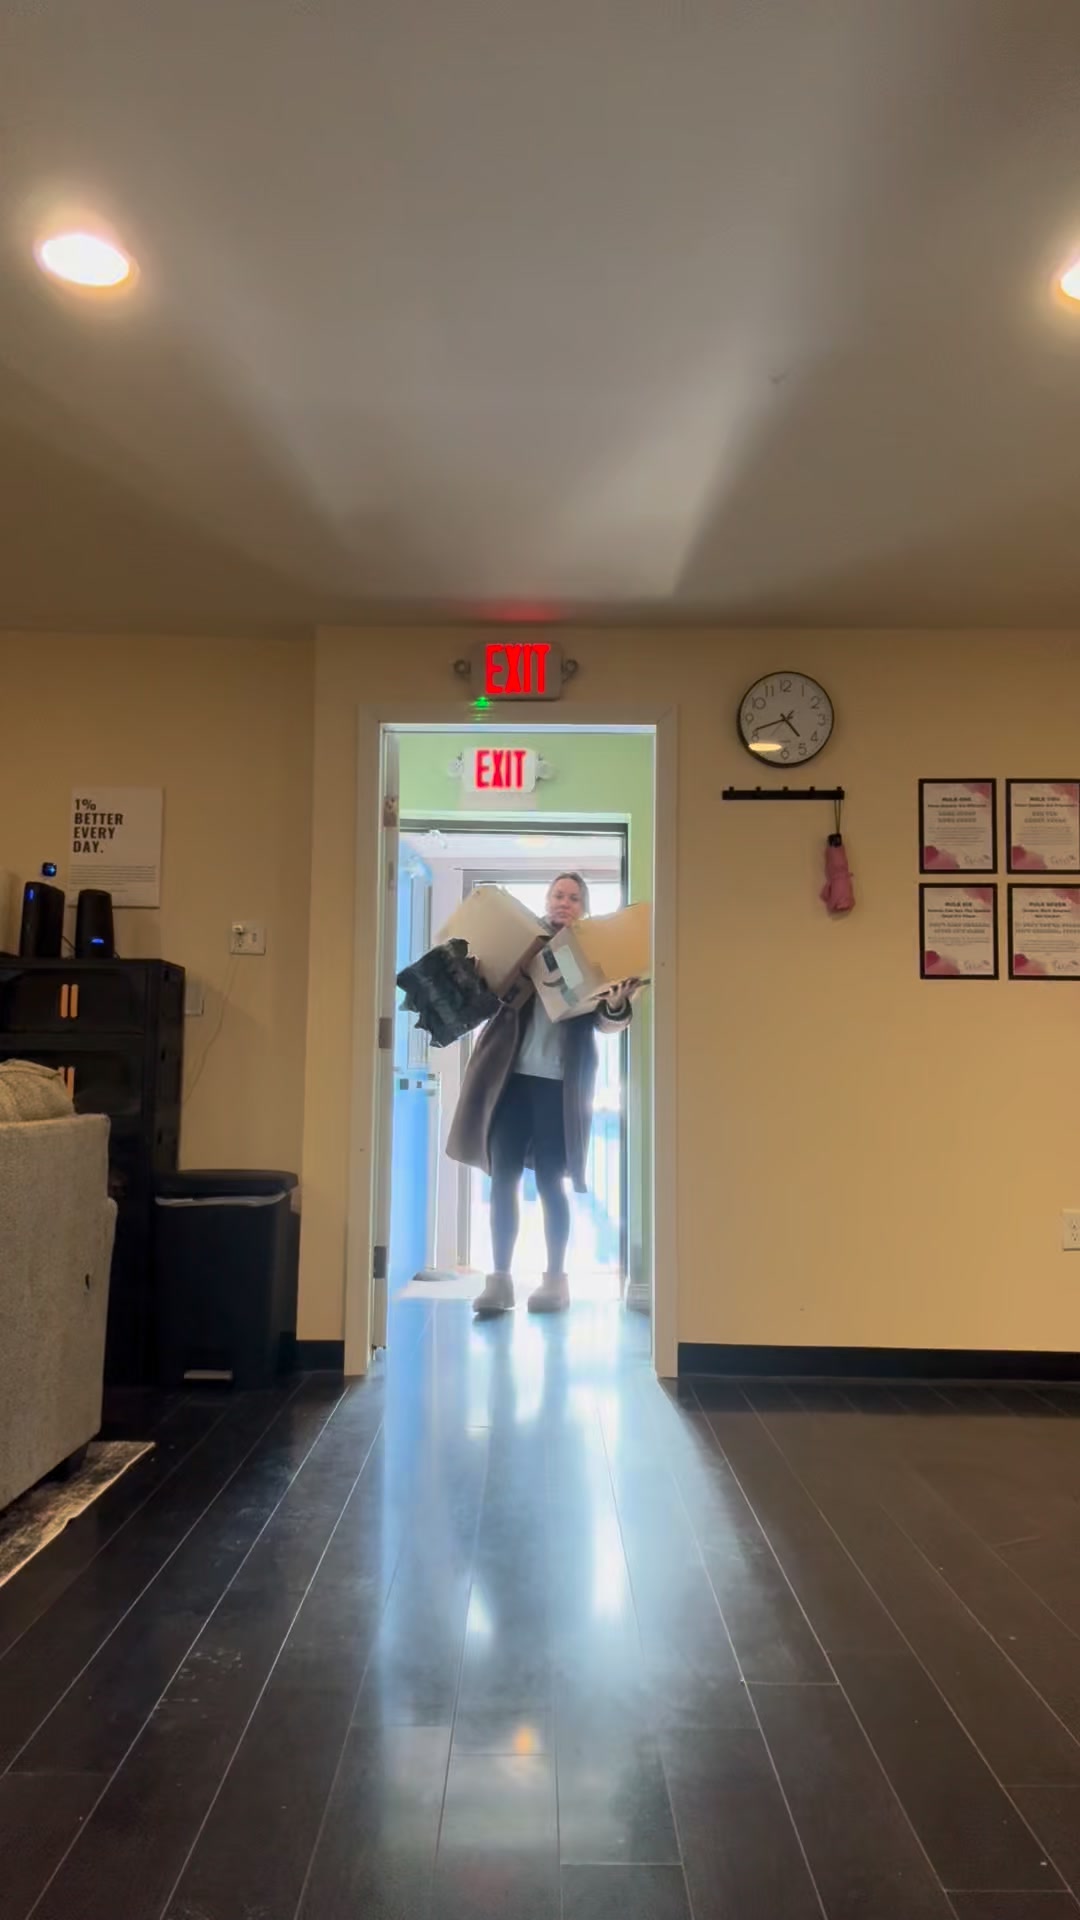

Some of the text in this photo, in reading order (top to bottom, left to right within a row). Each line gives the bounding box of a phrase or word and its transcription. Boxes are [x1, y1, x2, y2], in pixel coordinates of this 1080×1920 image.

[485, 643, 551, 694] EXIT
[765, 685, 775, 697] 11
[779, 679, 793, 693] 12
[752, 697, 766, 710] 10
[810, 696, 821, 709] 2
[745, 712, 754, 725] 9
[817, 714, 826, 727] 3
[810, 730, 818, 742] 4
[780, 747, 790, 760] 6
[798, 743, 807, 756] 5
[475, 749, 527, 790] EXIT
[75, 798, 97, 811] 1%
[74, 812, 124, 825] BETTER
[73, 826, 116, 839] EVERY
[73, 840, 104, 853] DAY.
